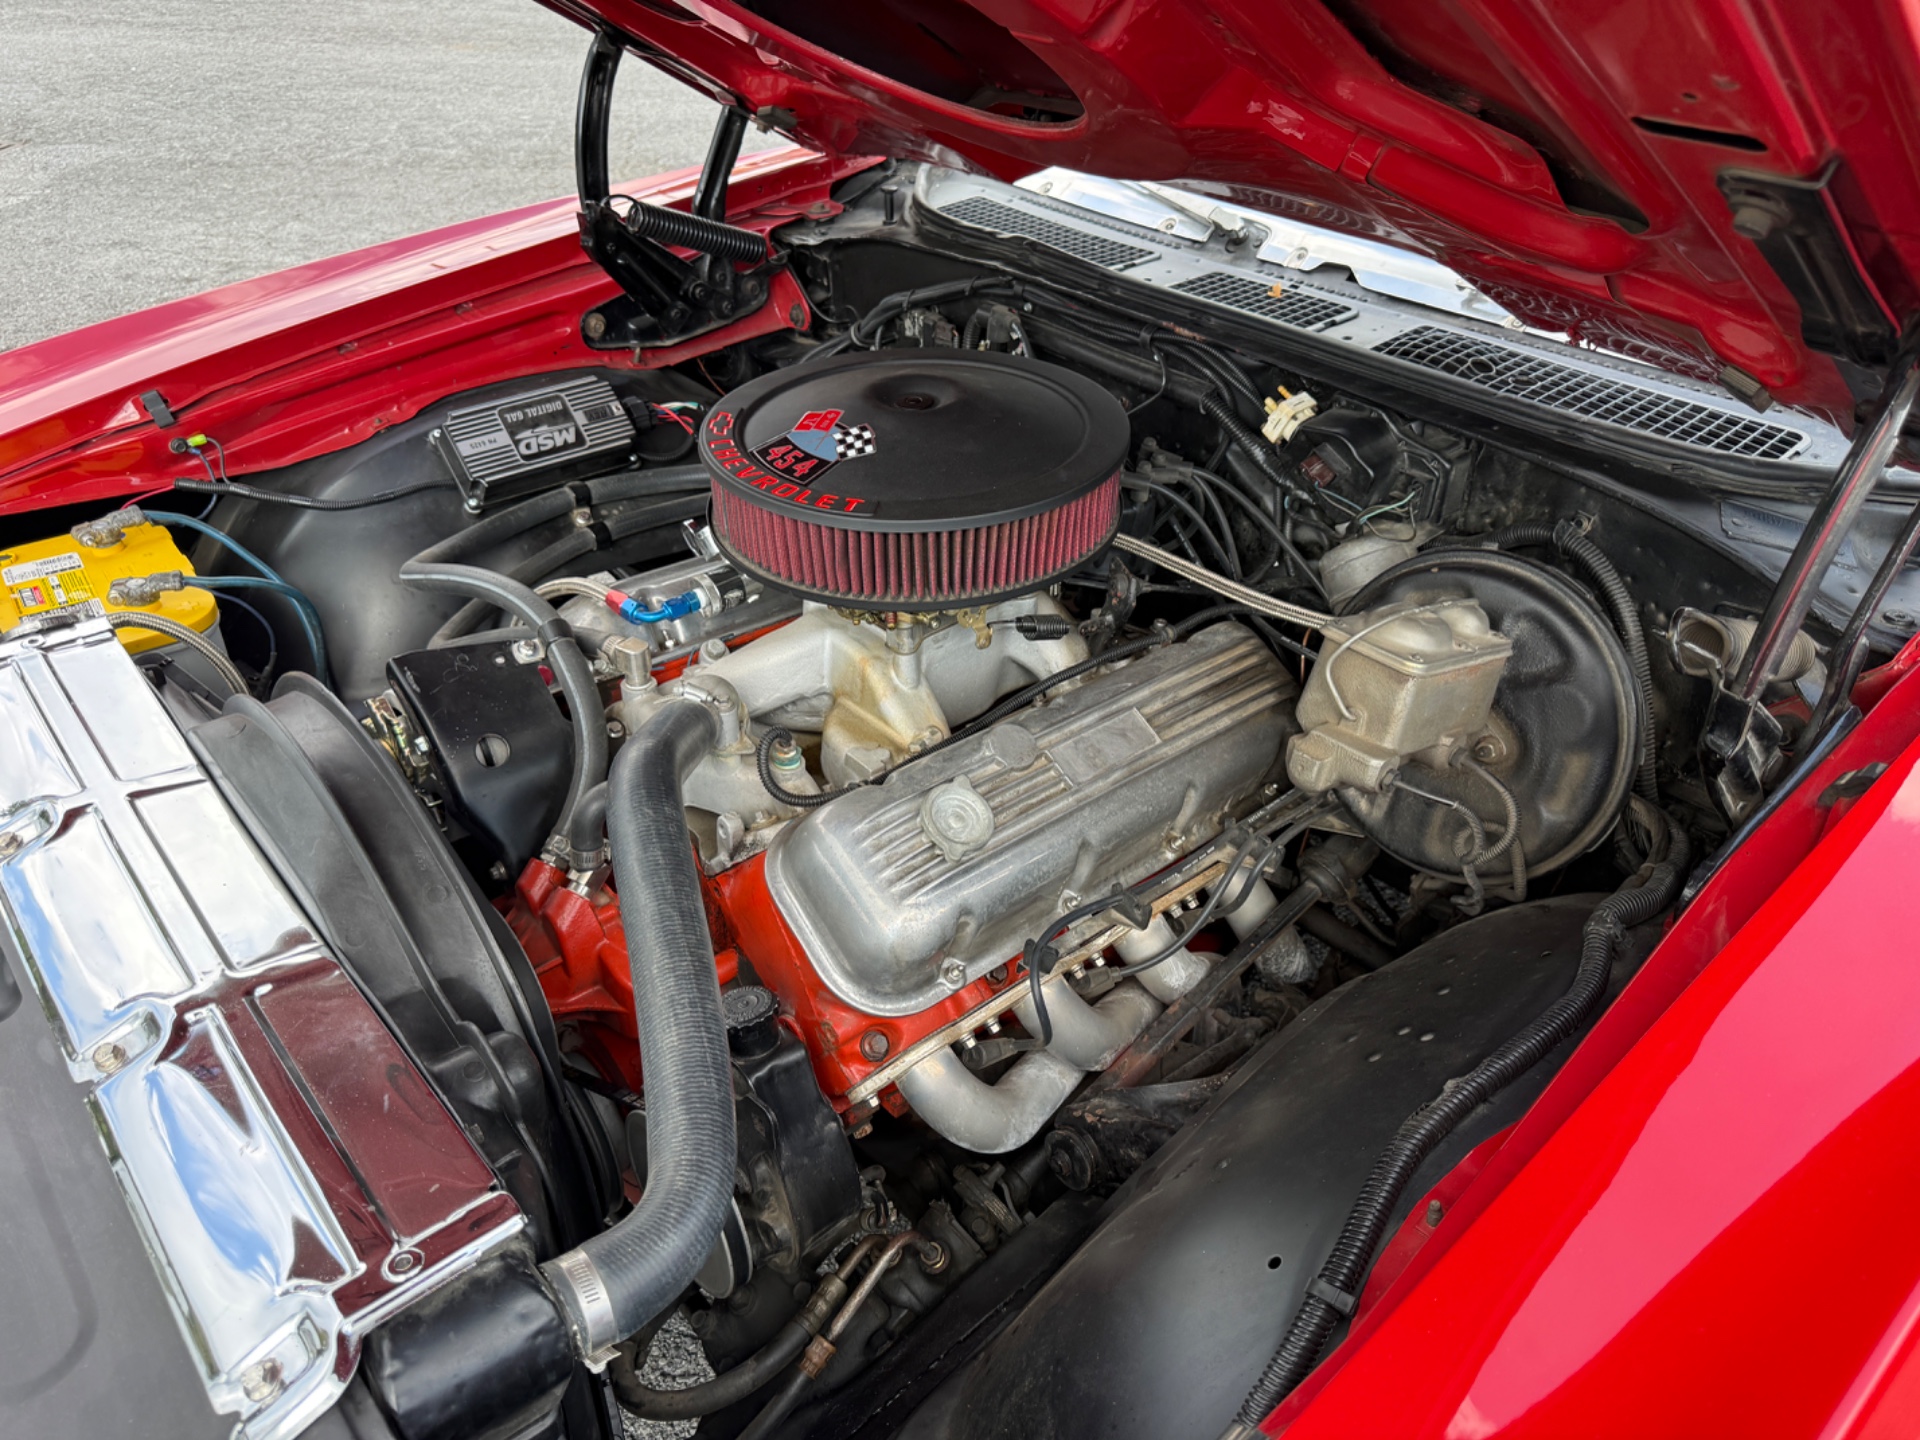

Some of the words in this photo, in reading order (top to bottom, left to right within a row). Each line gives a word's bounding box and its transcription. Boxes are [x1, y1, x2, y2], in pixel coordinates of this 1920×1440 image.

[503, 411, 525, 423] 6AL
[524, 400, 563, 418] DIGITAL
[518, 425, 577, 456] MSD
[708, 439, 865, 512] CHEVROLET
[766, 444, 819, 477] 454
